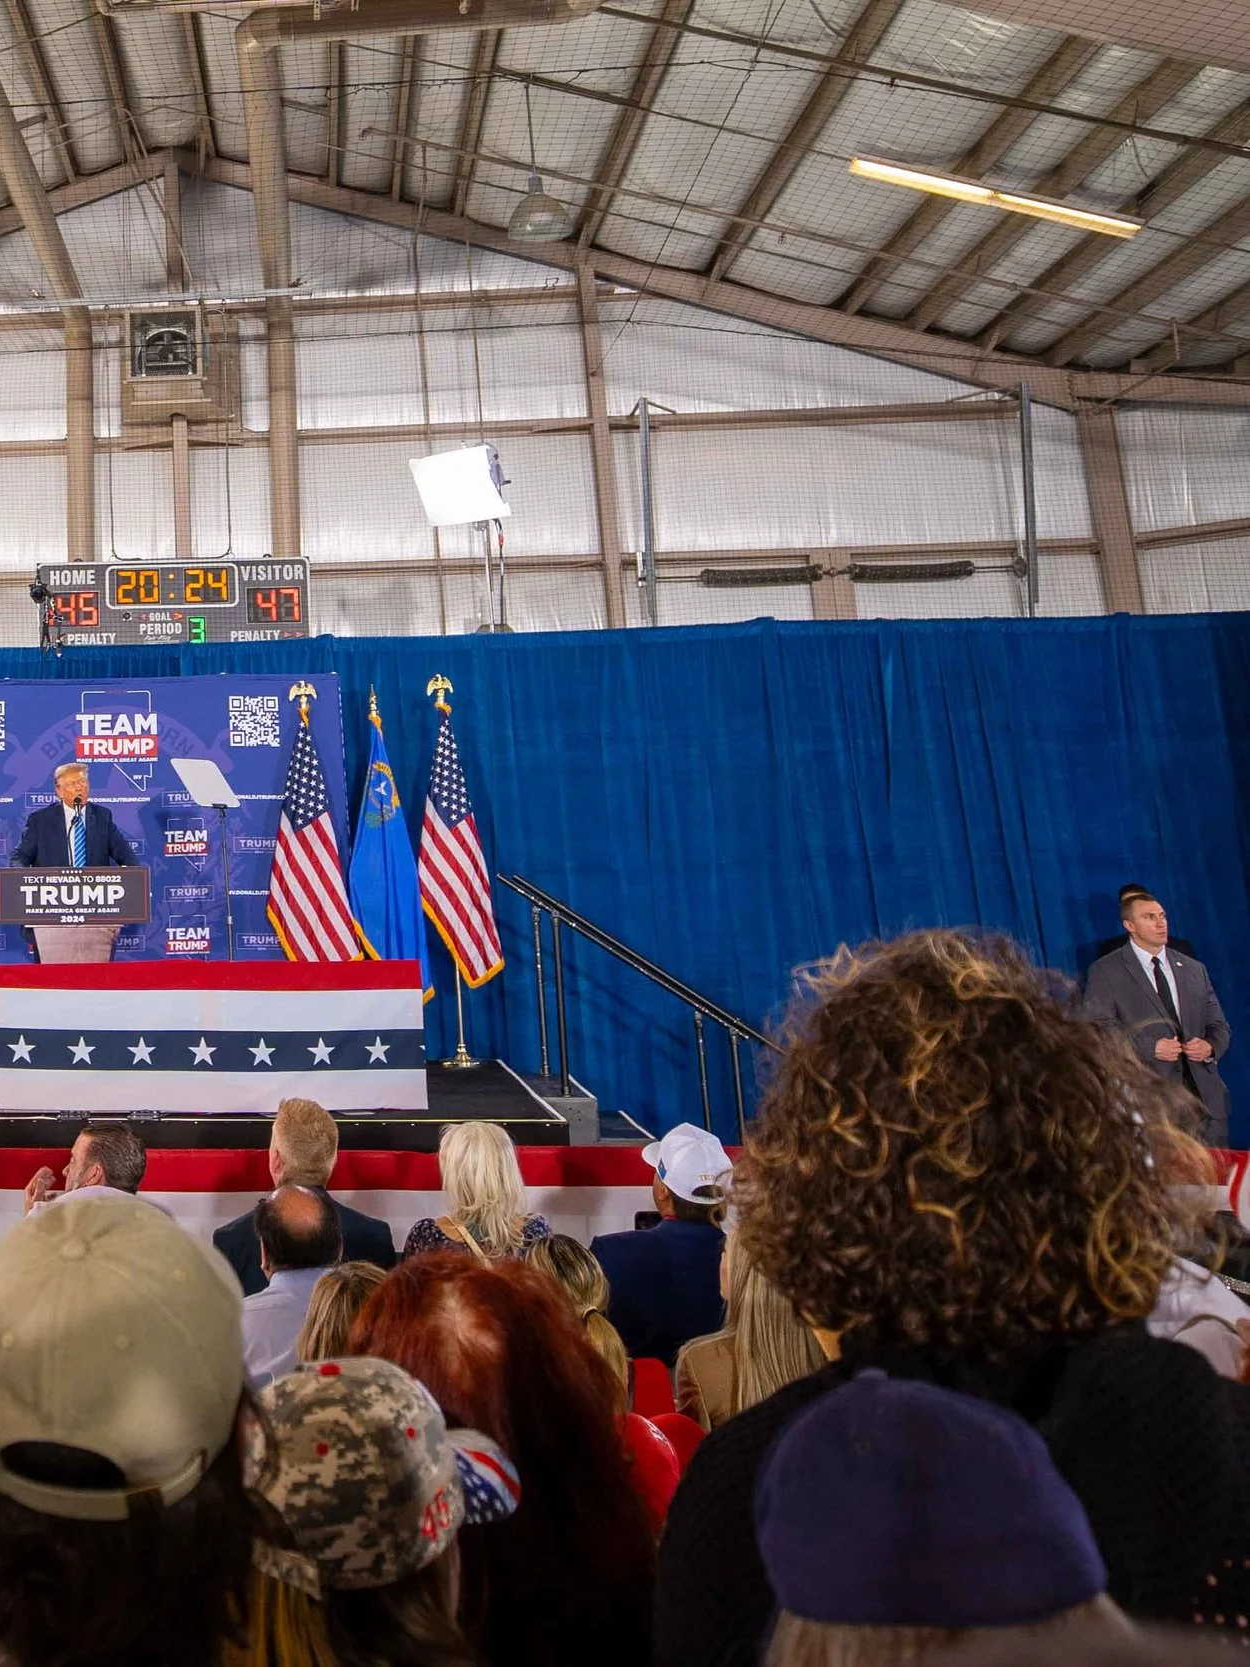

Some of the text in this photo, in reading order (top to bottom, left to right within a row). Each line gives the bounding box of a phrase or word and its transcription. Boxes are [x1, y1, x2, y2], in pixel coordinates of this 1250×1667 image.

[50, 570, 96, 586] HOME
[240, 565, 304, 581] VISITOR
[56, 592, 98, 626] 45
[255, 588, 300, 622] 47
[149, 613, 172, 621] GOAL
[140, 623, 182, 635] PERIOD
[189, 617, 205, 643] 3
[67, 633, 116, 645] PENALTY
[230, 630, 280, 642] PENALTY
[76, 713, 158, 735] TEAM
[79, 738, 155, 756] TRUMP
[165, 830, 207, 842] TEAM
[166, 843, 206, 853] TRUMP
[20, 885, 125, 905] TRUMP
[170, 888, 209, 897] TRUMP
[61, 915, 85, 923] 2024
[166, 928, 209, 940] TEAM
[168, 941, 208, 951] TRUMP
